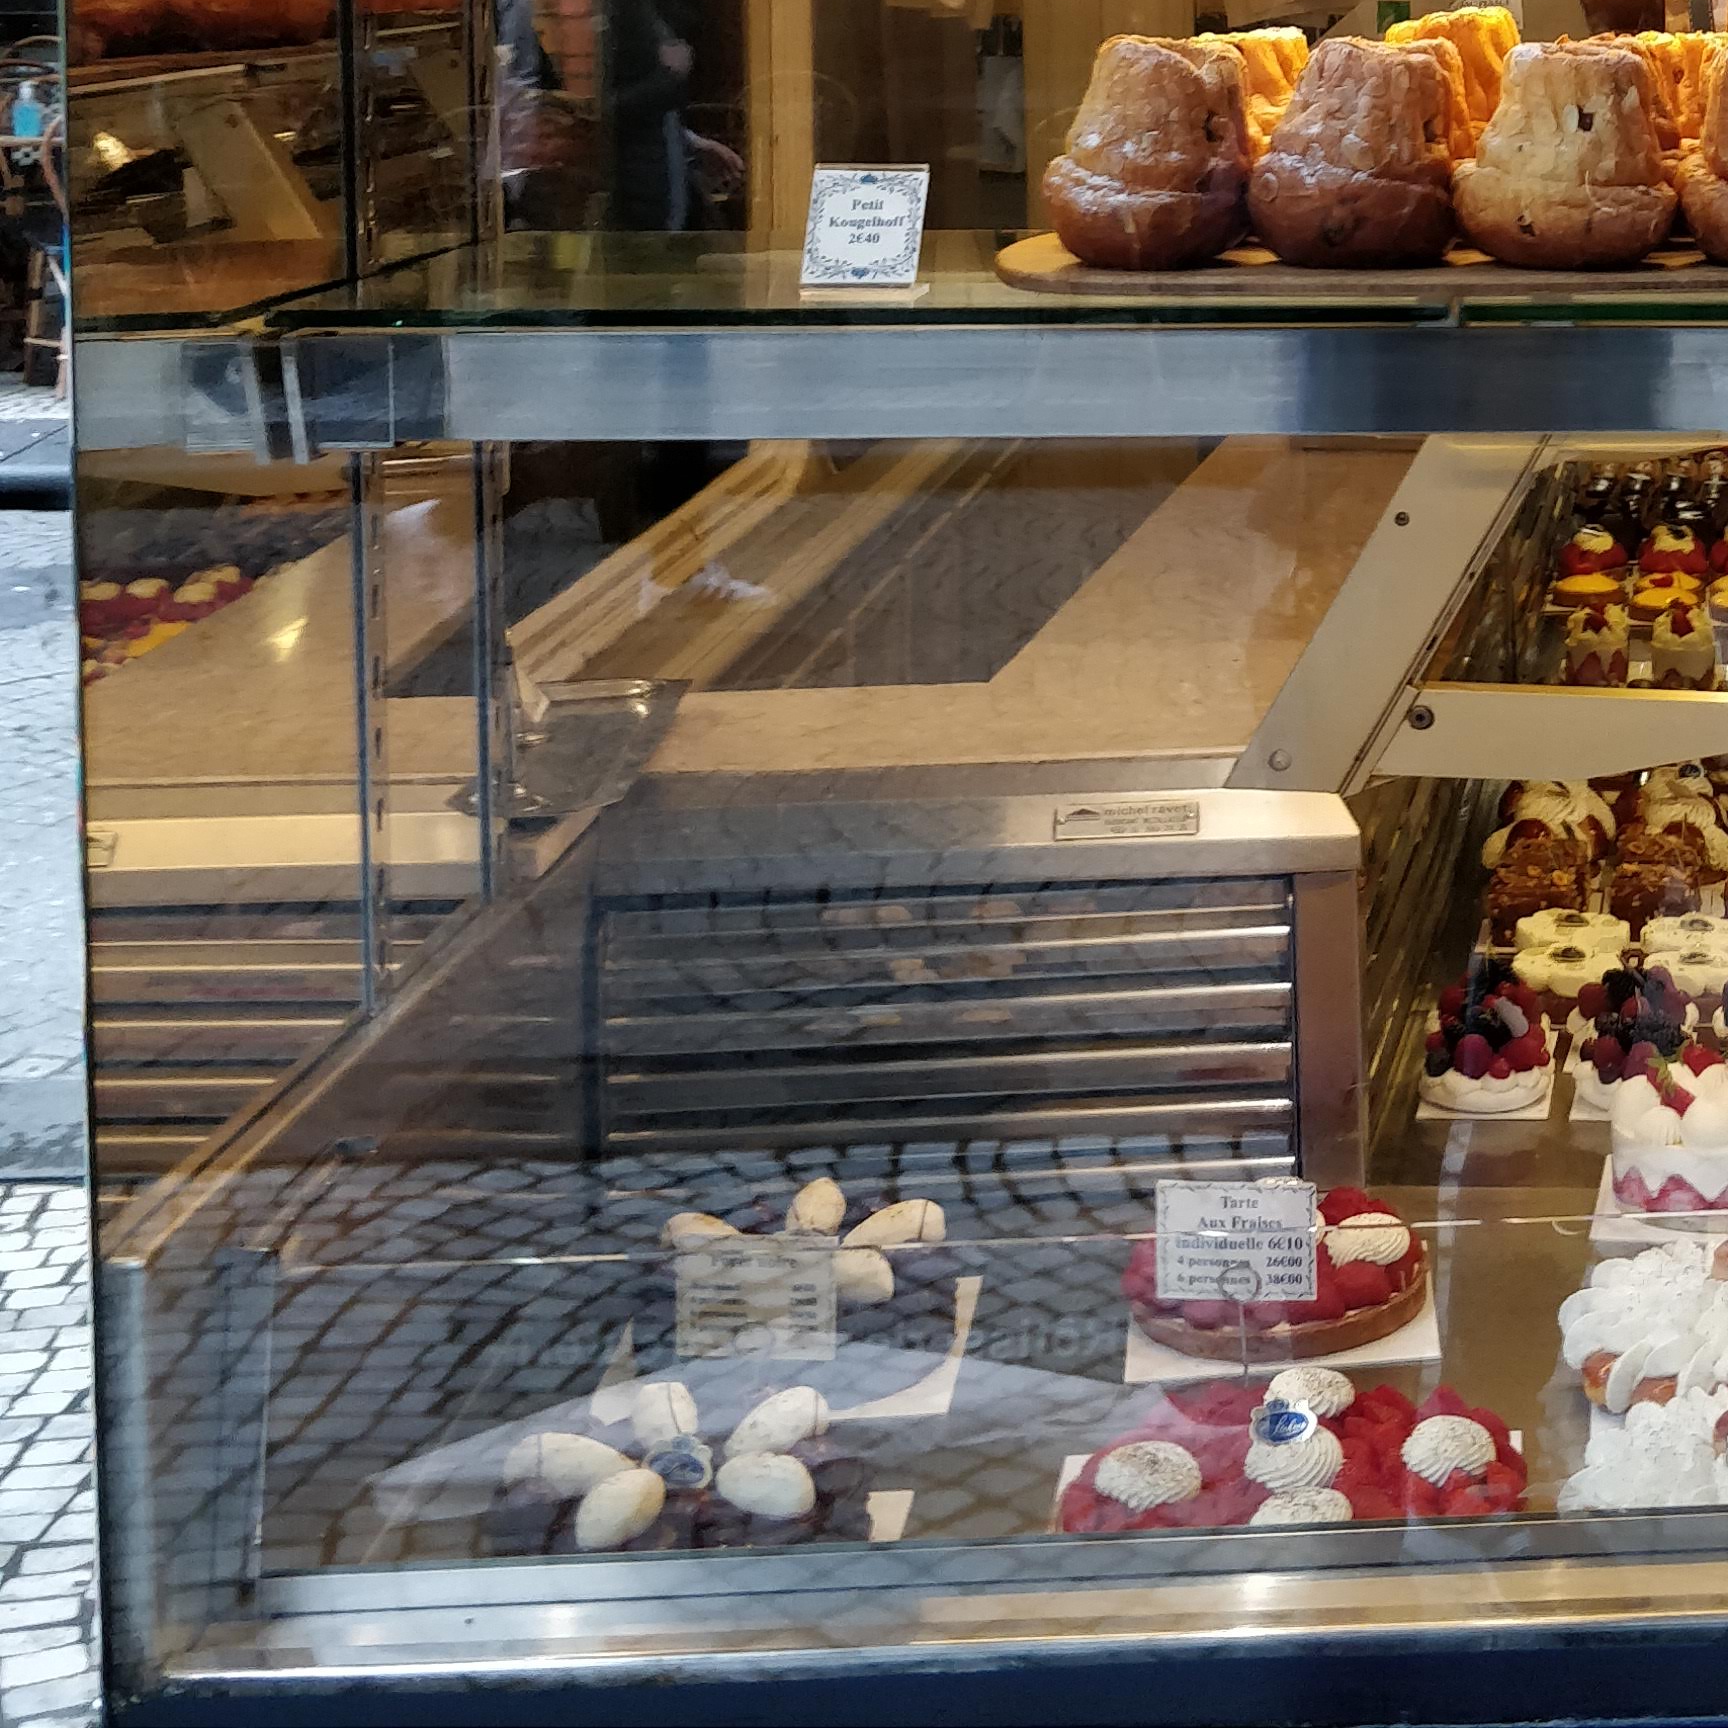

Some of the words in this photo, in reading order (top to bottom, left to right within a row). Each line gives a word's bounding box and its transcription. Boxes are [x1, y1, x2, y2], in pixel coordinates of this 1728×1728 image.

[851, 198, 885, 211] Petit
[848, 233, 880, 245] 2€40
[1220, 1195, 1259, 1210] Tarte
[1198, 1217, 1226, 1230] Aux
[1231, 1216, 1282, 1230] Fraises
[1267, 1236, 1303, 1251] 6€10
[1177, 1256, 1185, 1266] 4
